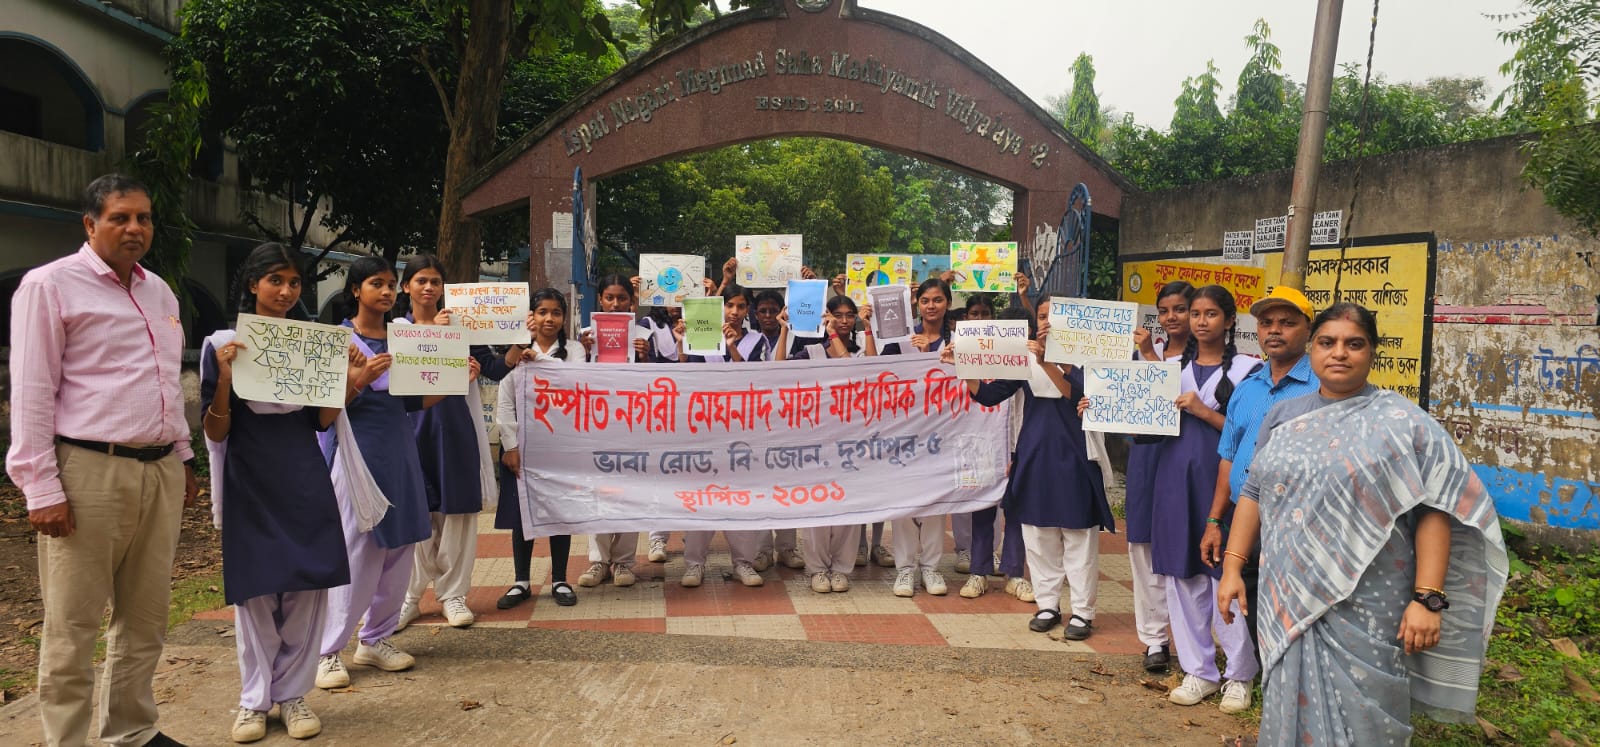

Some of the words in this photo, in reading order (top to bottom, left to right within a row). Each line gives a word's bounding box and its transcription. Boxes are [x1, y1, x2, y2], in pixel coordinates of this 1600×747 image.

[561, 109, 609, 157] Ispat
[775, 49, 822, 75] Saha
[828, 51, 940, 109] Madhyamik
[1274, 217, 1286, 225] TANK
[1326, 211, 1339, 219] TANK
[1257, 225, 1285, 234] CLEANER
[1257, 234, 1276, 242] SANJIB
[1224, 239, 1252, 247] CLEANER
[1224, 246, 1243, 254] SANJIB
[1343, 256, 1391, 275] সরকার
[1156, 264, 1176, 280] নতুন
[1178, 266, 1212, 282] ফোনের
[1214, 267, 1233, 284] ছবি
[1234, 273, 1261, 288] দেখে
[1371, 282, 1409, 306] বাণিজ্য
[534, 376, 610, 433] ইস্পাত
[615, 376, 680, 433] নগরী
[687, 381, 773, 433] মেঘনাদ
[778, 381, 823, 429] সাহা
[829, 371, 918, 427] মাধ্যমিক
[593, 450, 650, 473] ভাবা
[660, 450, 718, 476] রোড,
[674, 483, 751, 512] স্থাপিত
[772, 480, 845, 507] ২০০১
